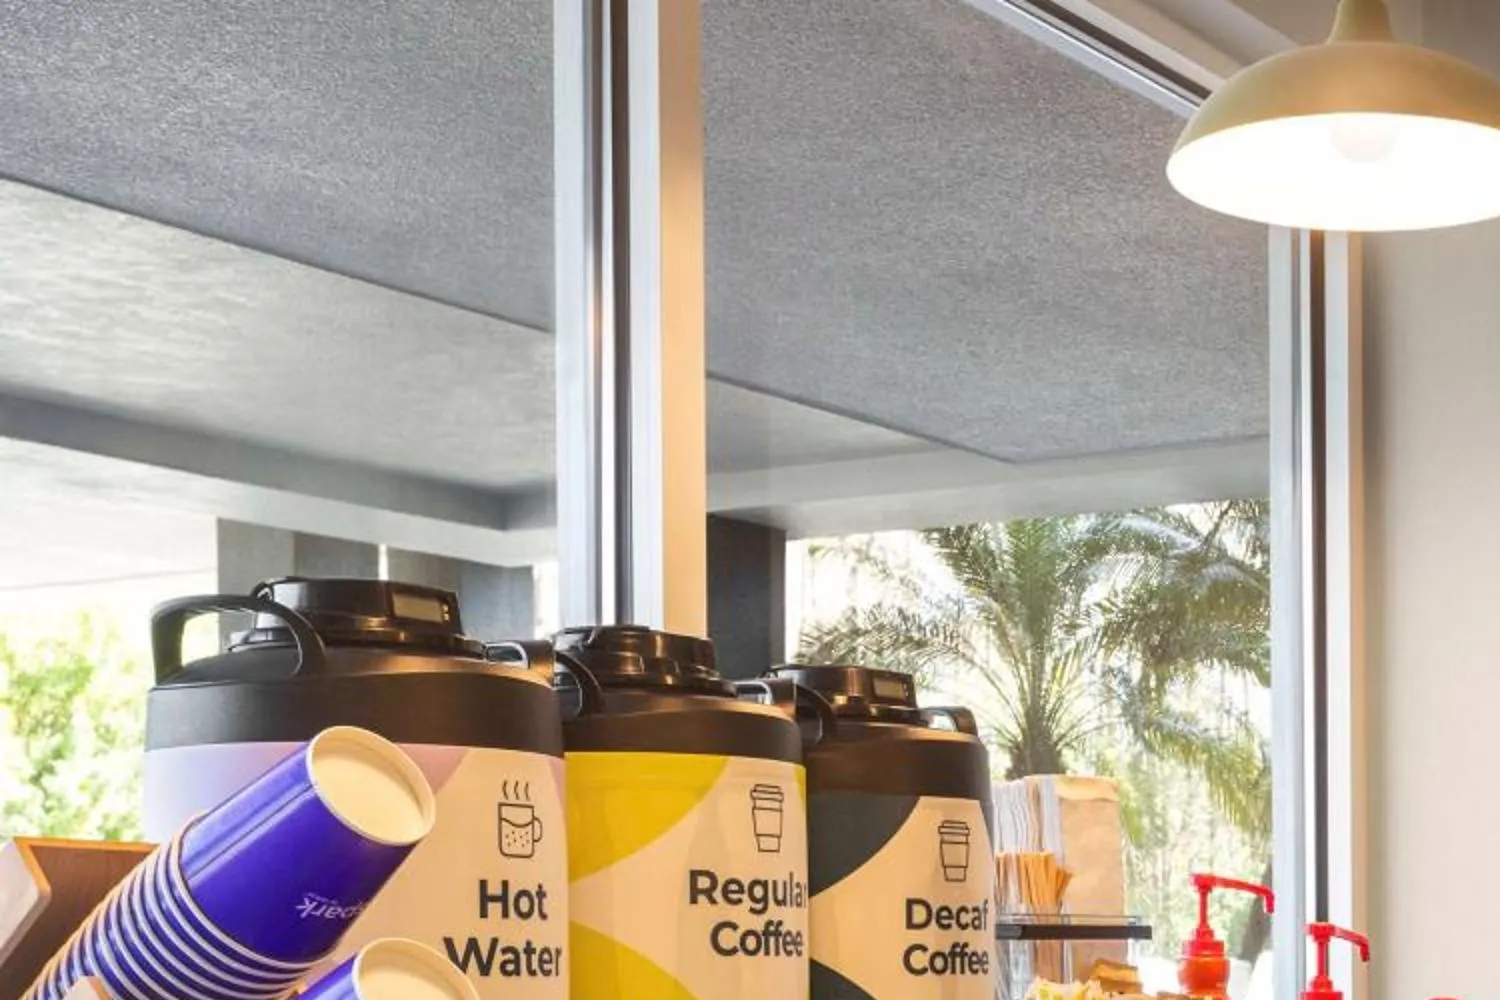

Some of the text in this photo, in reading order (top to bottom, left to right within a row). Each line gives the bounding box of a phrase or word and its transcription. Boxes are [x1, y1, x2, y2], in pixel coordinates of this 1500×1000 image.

[295, 897, 364, 919] park
[479, 879, 548, 920] Hot
[906, 898, 988, 931] Decaf
[711, 920, 804, 957] Coffee
[443, 936, 562, 977] Water
[903, 942, 989, 976] Coffee
